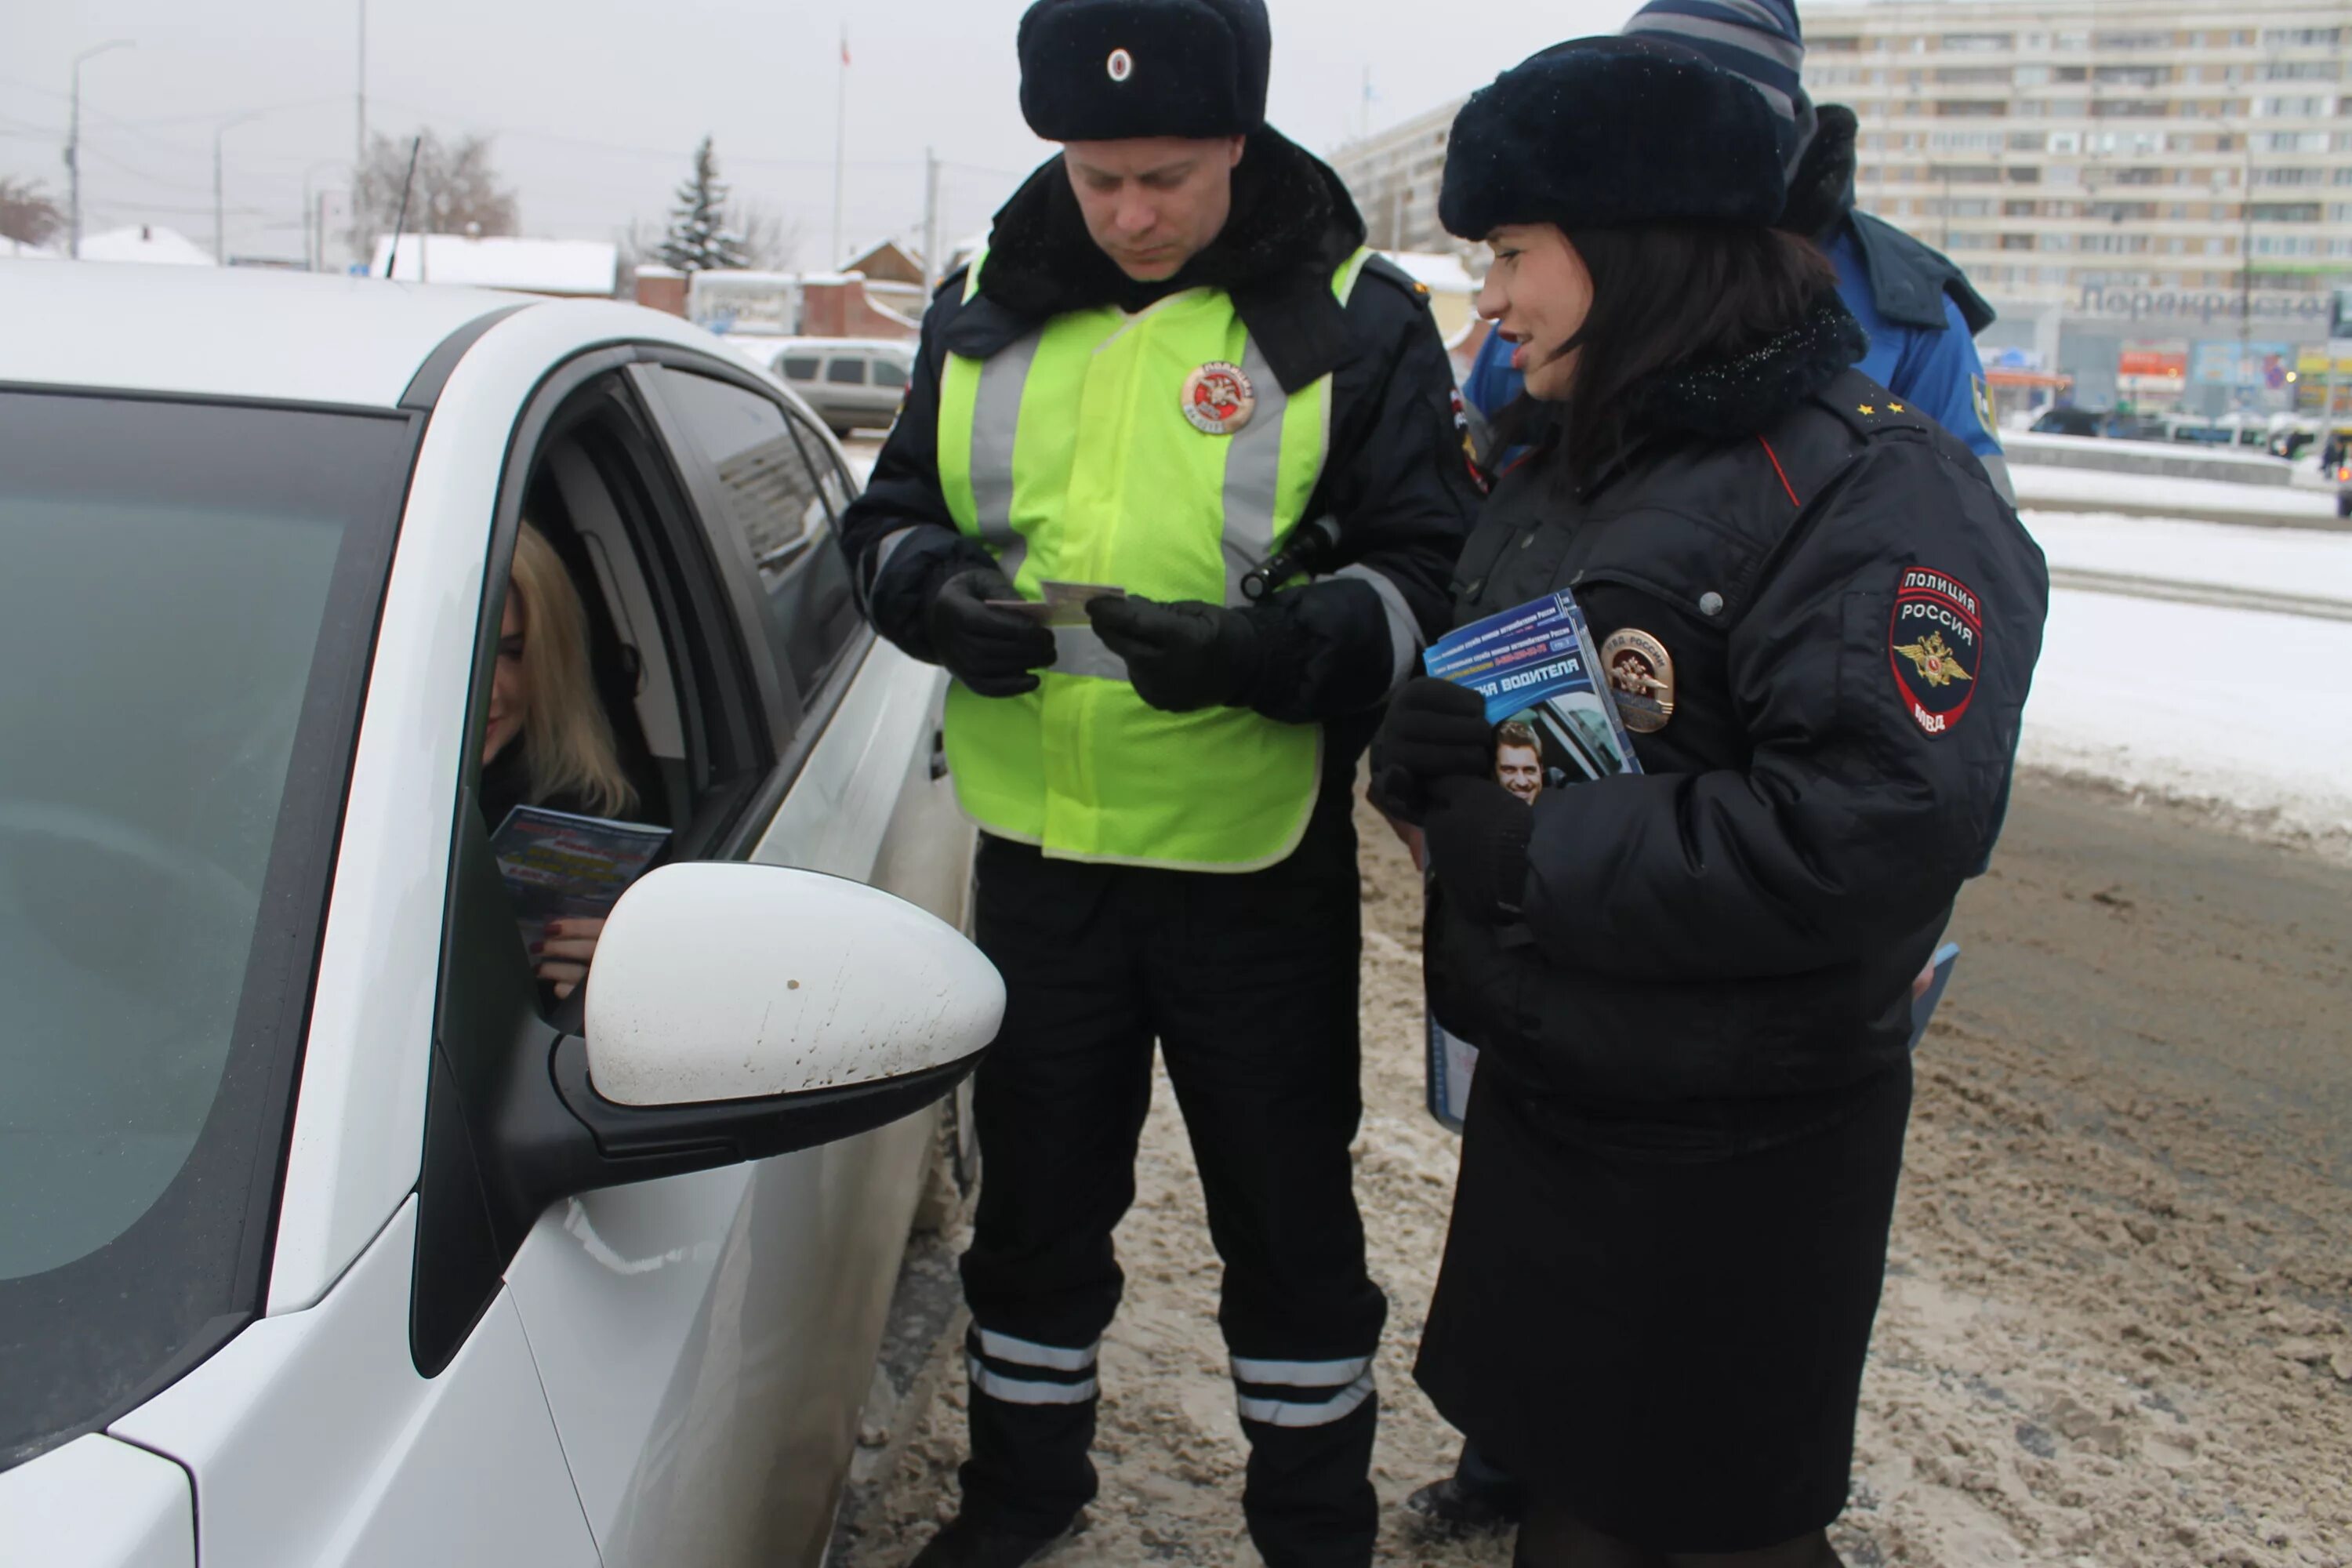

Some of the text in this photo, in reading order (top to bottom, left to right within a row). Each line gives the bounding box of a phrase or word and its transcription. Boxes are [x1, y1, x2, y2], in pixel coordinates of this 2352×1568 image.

[1905, 572, 1976, 615] ПОЛИЦИЯ
[1901, 604, 1973, 646] РОССИЯ
[1630, 636, 1665, 667] РОССИИ
[1501, 658, 1580, 691] ВОДИТЕЛЯ
[1915, 703, 1946, 732] МВД
